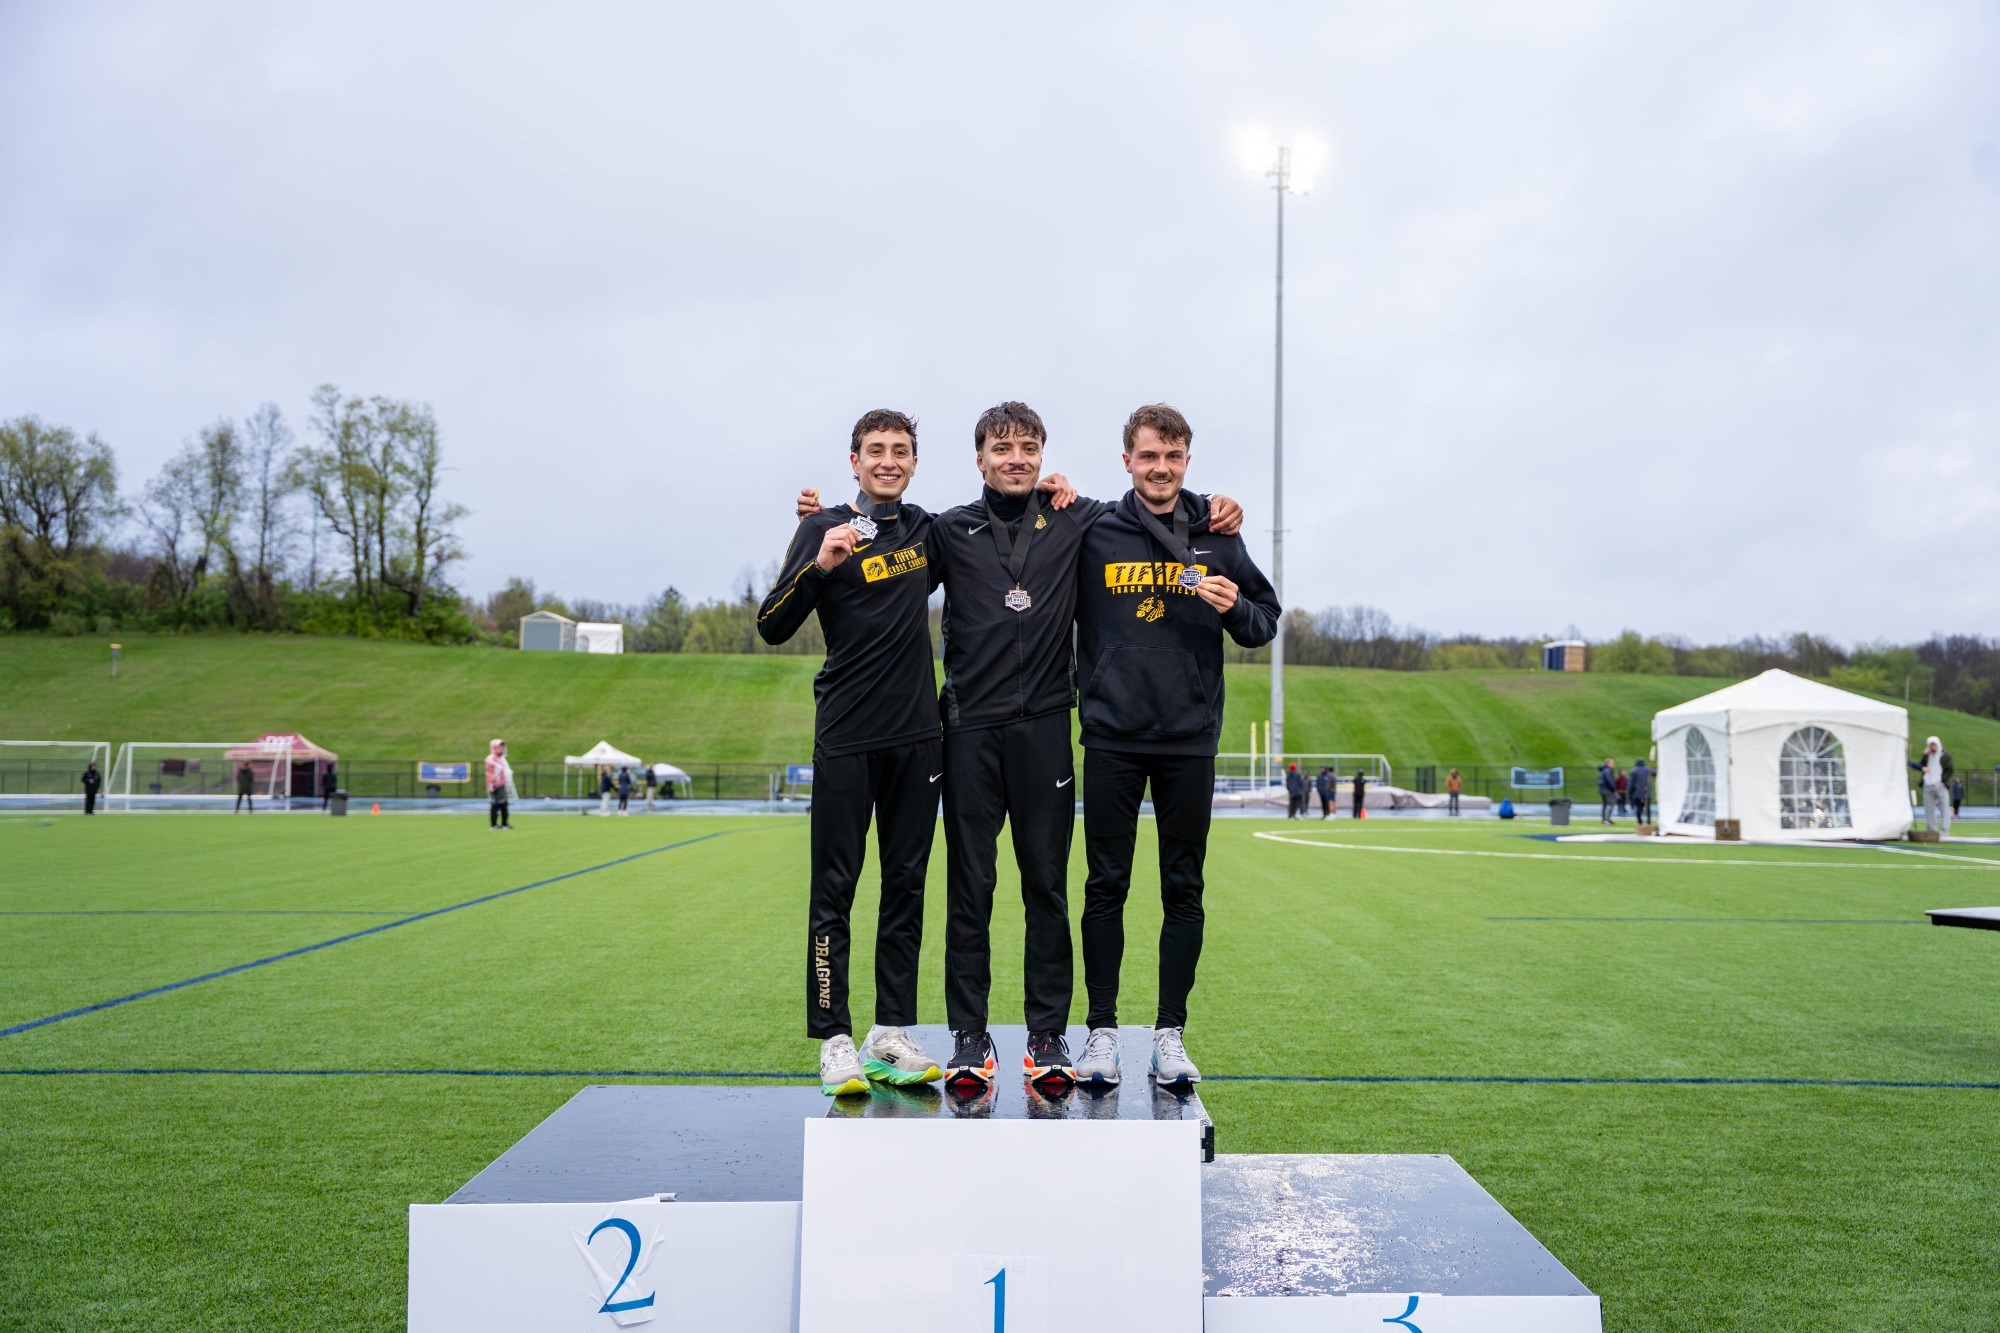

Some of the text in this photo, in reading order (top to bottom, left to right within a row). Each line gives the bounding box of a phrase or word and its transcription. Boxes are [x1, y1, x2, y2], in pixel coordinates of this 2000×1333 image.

[893, 549, 918, 564] TIFFIN
[888, 562, 908, 575] CROSS
[1115, 565, 1179, 584] TIFFI
[1112, 585, 1143, 595] TRACK
[1166, 585, 1196, 596] FIELD
[815, 935, 831, 1009] DRAGONS
[587, 1218, 656, 1314] 2
[983, 1268, 1006, 1333] 1
